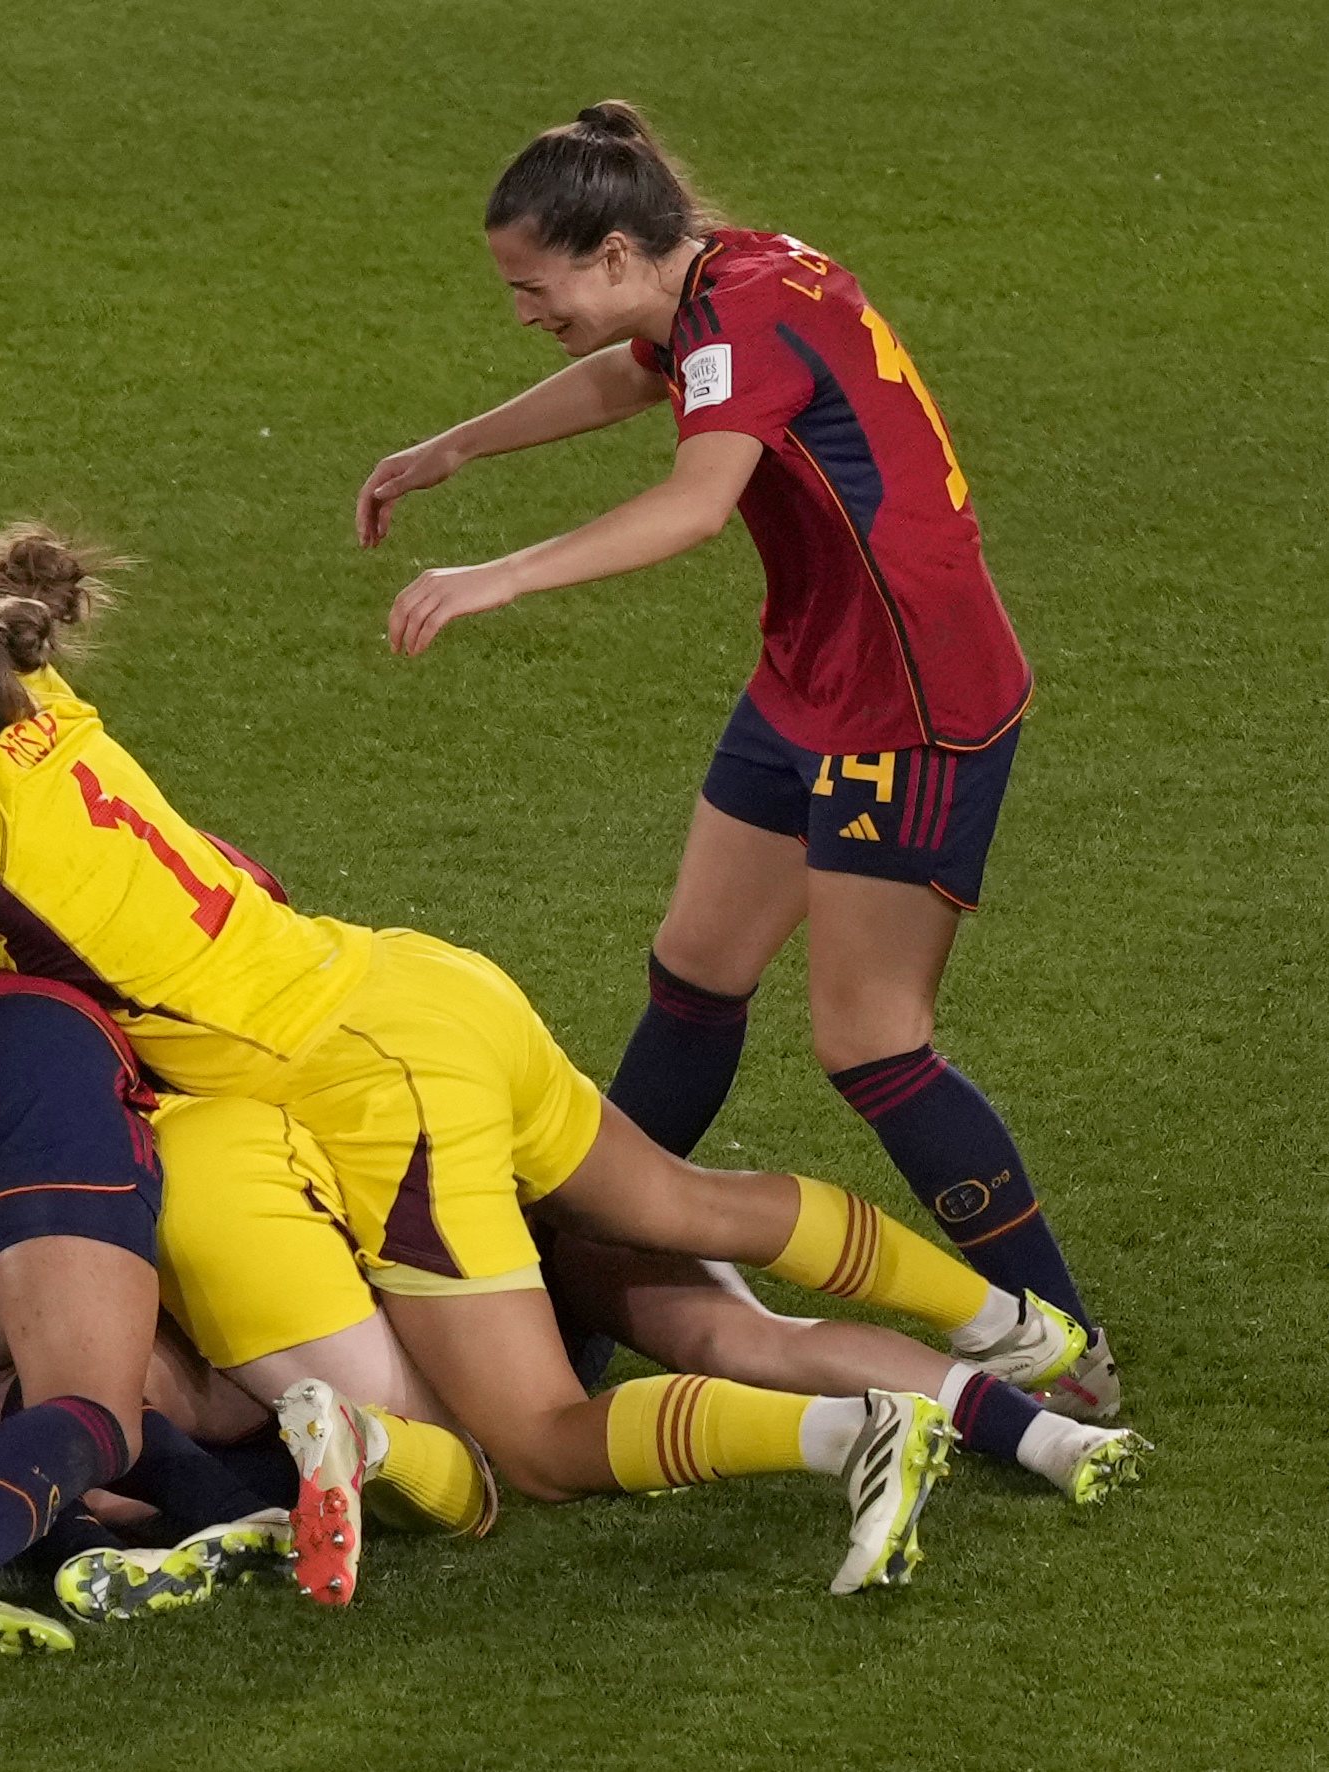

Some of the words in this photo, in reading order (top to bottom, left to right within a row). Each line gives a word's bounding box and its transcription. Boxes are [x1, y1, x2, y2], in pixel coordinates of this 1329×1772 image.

[689, 363, 717, 380] NITES
[812, 752, 896, 803] 14
[70, 761, 234, 940] 1
